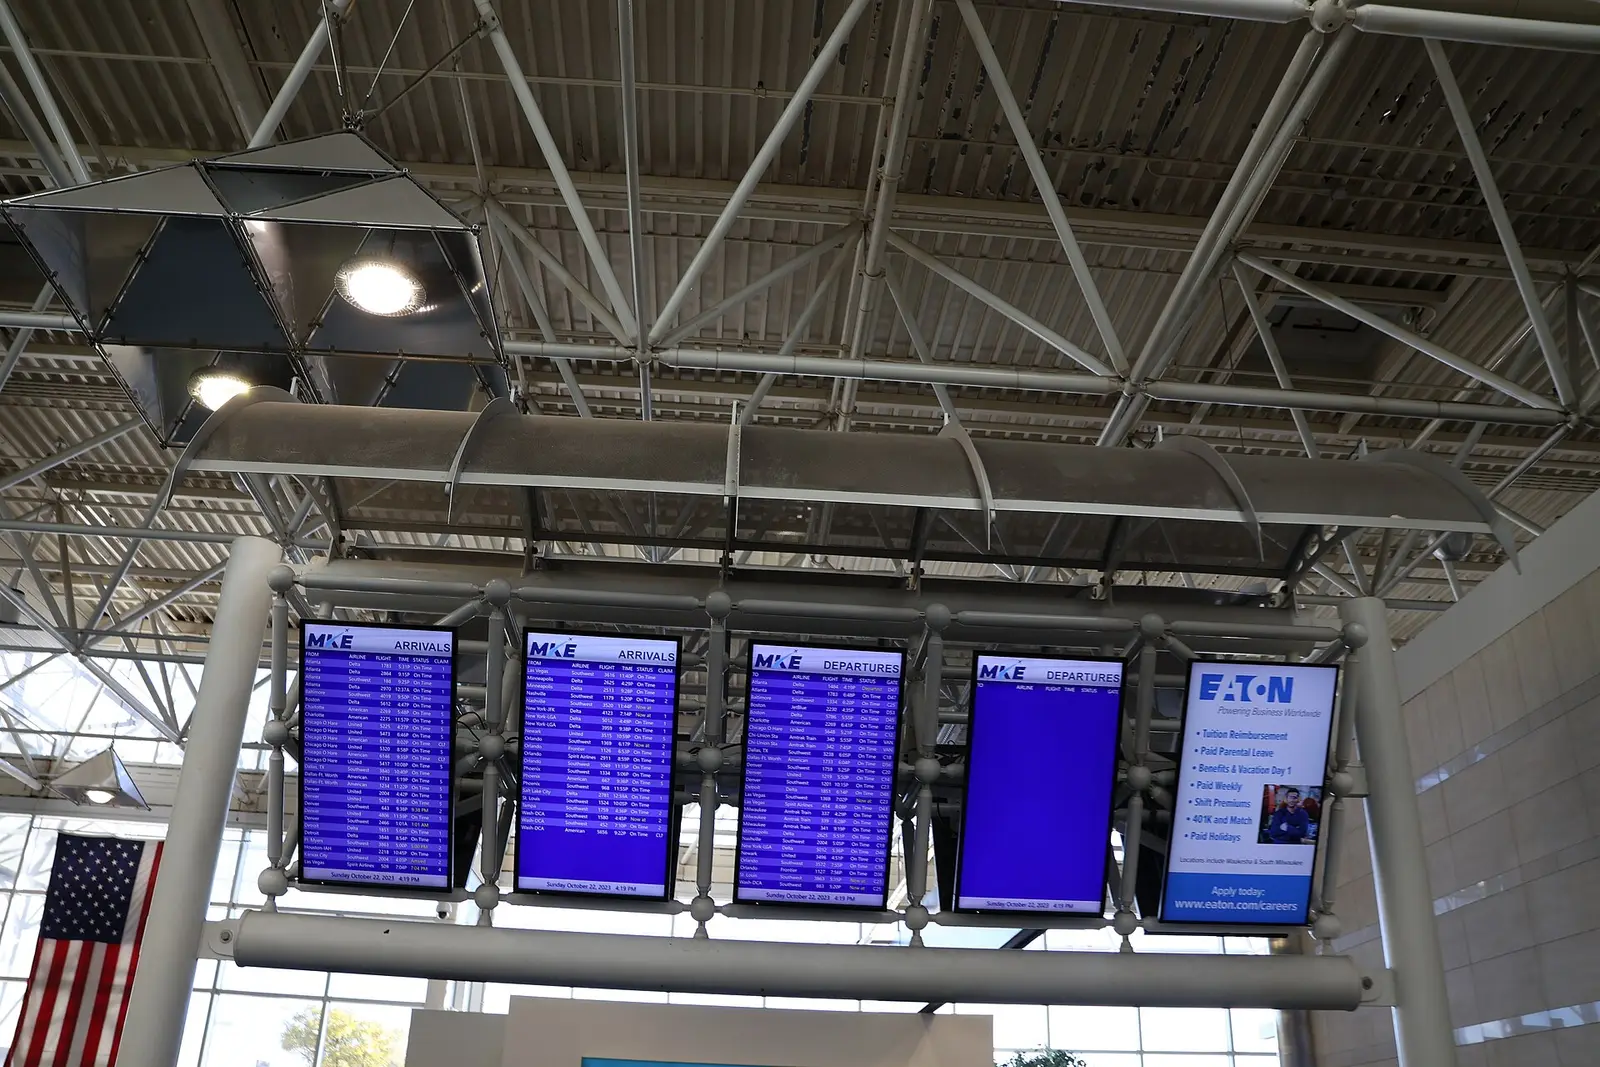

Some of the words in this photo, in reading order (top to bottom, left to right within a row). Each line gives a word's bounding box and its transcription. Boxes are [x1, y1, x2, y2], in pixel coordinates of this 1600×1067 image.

[307, 632, 353, 649] MKE
[394, 640, 450, 652] ARRIVALS
[529, 641, 576, 658] MKE
[618, 649, 674, 661] ARRIVALS
[754, 653, 802, 670] MKE
[823, 660, 899, 673] DEPARTURES
[979, 664, 1026, 680] MKE
[1046, 670, 1120, 683] DEPARTURES
[1198, 673, 1293, 703] EATON
[1217, 705, 1251, 716] Powering
[1251, 706, 1283, 716] Business
[1283, 708, 1321, 718] Worldwide
[1202, 728, 1228, 738] Tuition
[1229, 729, 1288, 741] Reimbursement
[1200, 746, 1217, 755] Paid
[1218, 746, 1250, 756] Parental
[1252, 748, 1274, 757] Leave
[1198, 763, 1229, 773] Benefits
[1230, 765, 1236, 773] &
[1238, 764, 1270, 774] Vacation
[1270, 765, 1285, 776] Day
[1196, 781, 1213, 789] Paid
[1214, 781, 1242, 792] Weekly
[1194, 797, 1212, 806] Shift
[1213, 798, 1251, 808] Premiums
[1192, 814, 1212, 824] 401K
[1213, 815, 1228, 824] and
[1228, 815, 1252, 825] Match
[1190, 831, 1207, 840] Paid
[1208, 831, 1241, 843] Holidays
[1210, 886, 1236, 897] Apply
[1237, 886, 1266, 898] today:
[1173, 898, 1298, 912] www.eaton.com/careers
